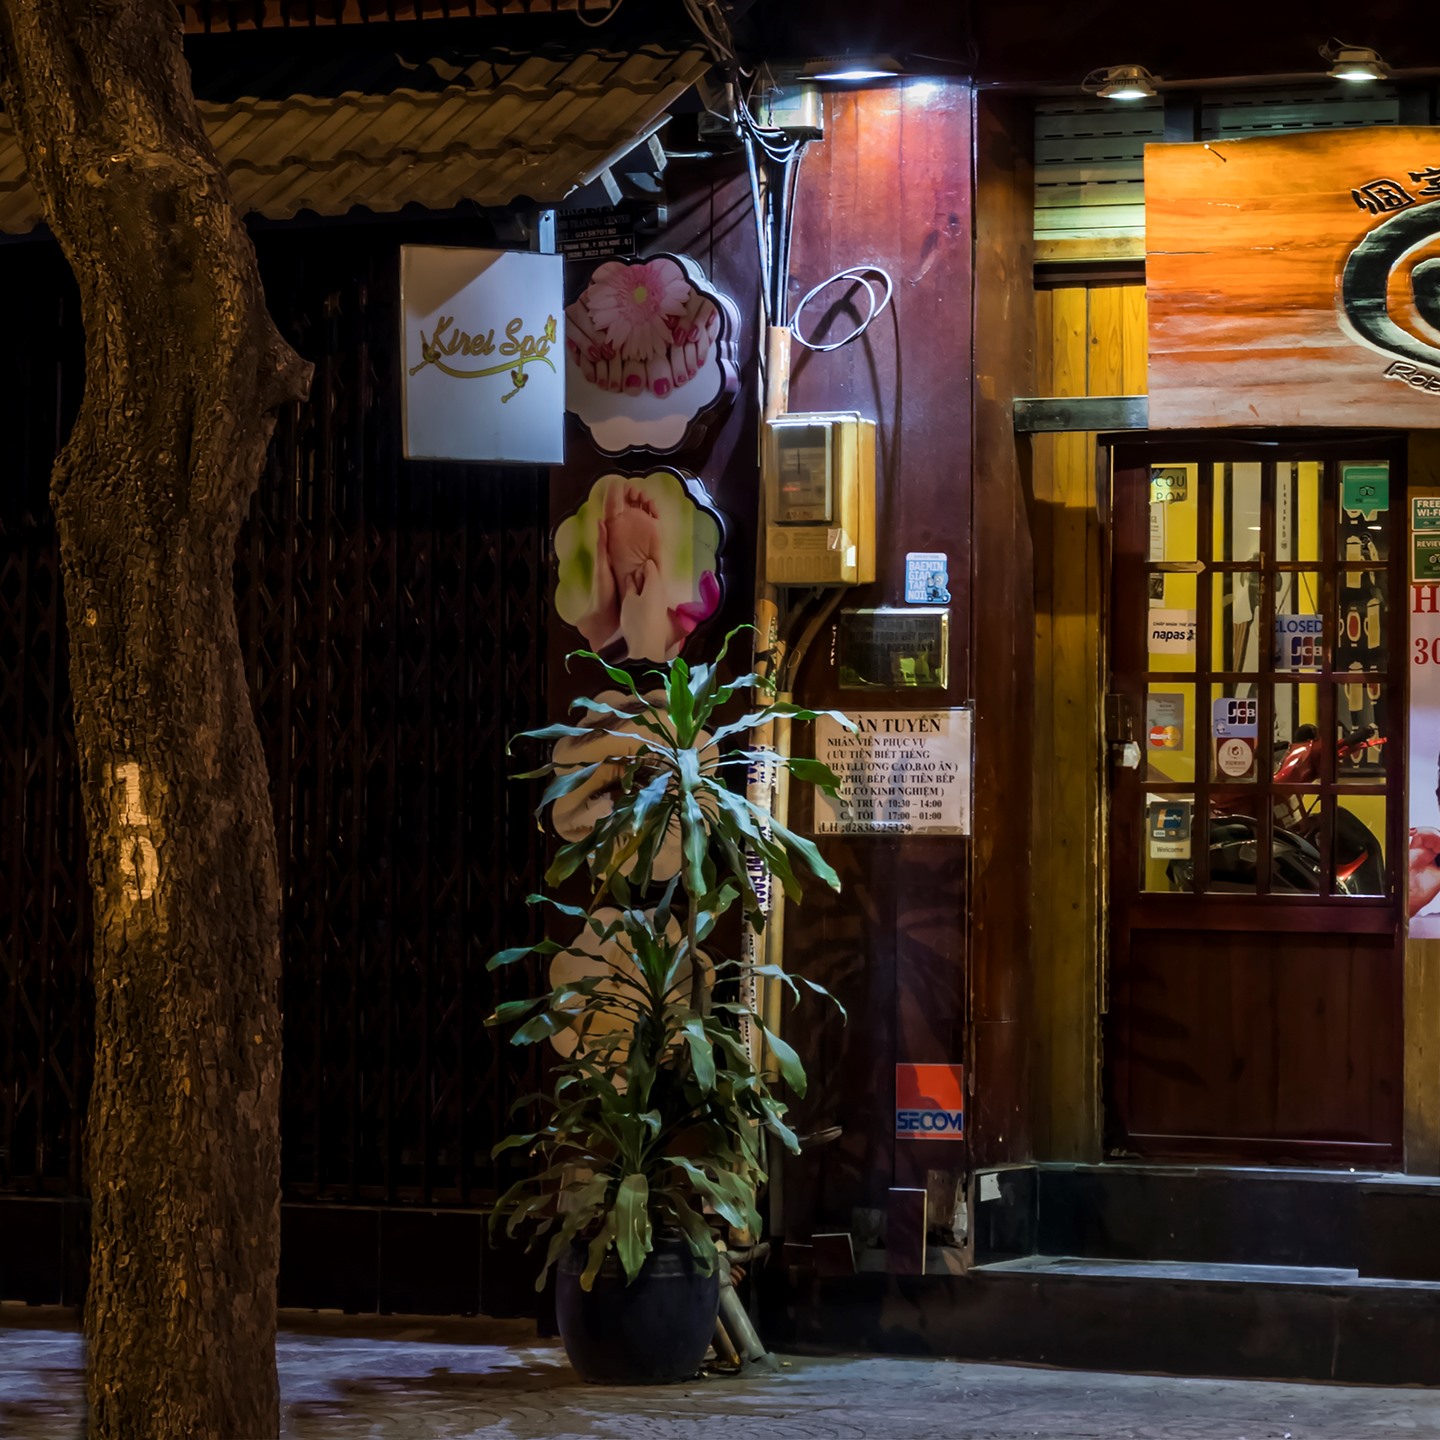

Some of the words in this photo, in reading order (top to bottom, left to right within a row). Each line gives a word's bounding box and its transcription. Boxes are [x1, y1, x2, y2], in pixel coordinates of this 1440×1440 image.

[429, 315, 496, 358] Kirei
[499, 317, 552, 369] Spa
[1417, 500, 1440, 508] FREE
[1152, 630, 1185, 642] napas
[1228, 708, 1257, 717] JCB
[888, 799, 910, 808] 10:30
[920, 799, 943, 809] 14:00
[888, 811, 910, 820] 17:00
[919, 811, 942, 820] 01:00
[896, 1110, 964, 1132] SECOM
